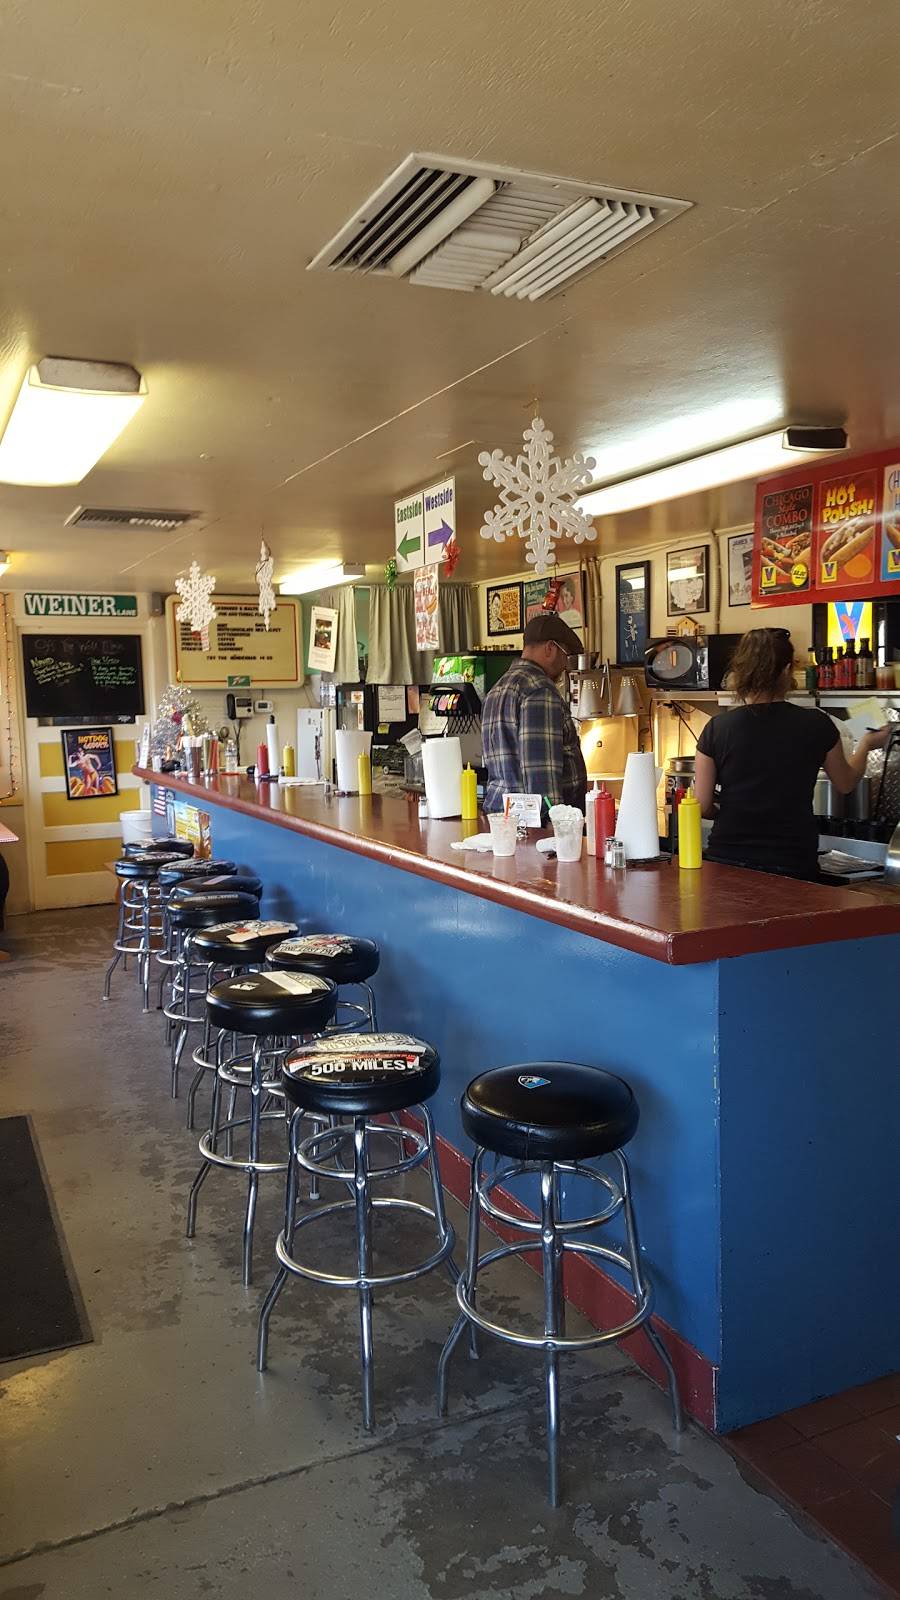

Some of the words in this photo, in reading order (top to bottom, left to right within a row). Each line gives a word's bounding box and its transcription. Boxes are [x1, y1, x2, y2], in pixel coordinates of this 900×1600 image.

[425, 488, 452, 512] Westside
[765, 488, 810, 508] CHICAGO
[825, 484, 856, 507] HOT
[397, 500, 422, 523] Eastside
[767, 508, 808, 528] COMBO
[823, 498, 874, 524] POLISH!
[25, 594, 117, 616] WEINER
[311, 1061, 346, 1075] 500
[351, 1059, 406, 1071] MILES
